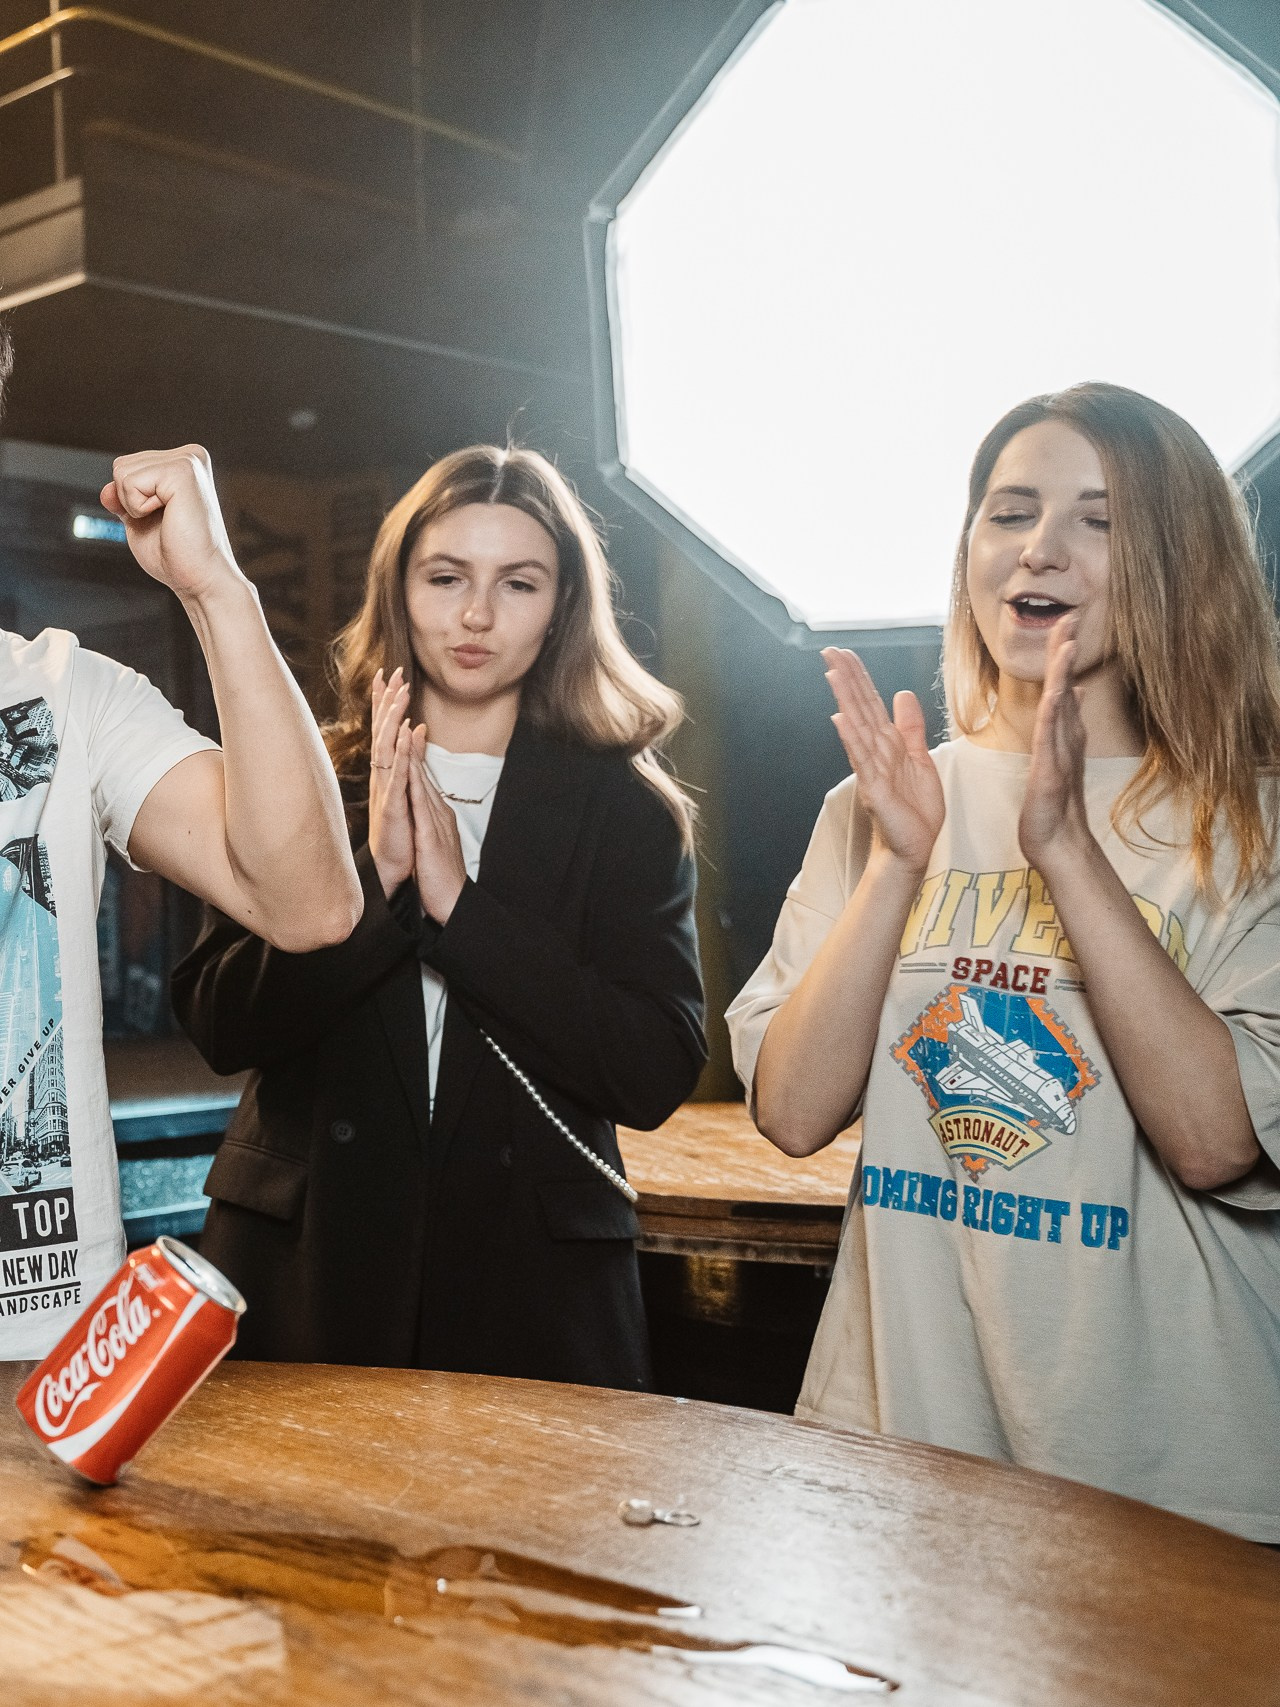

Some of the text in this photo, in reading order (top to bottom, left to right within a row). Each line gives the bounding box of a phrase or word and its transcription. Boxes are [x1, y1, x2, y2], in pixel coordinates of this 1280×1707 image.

[951, 956, 1052, 995] SPACE
[18, 1041, 42, 1074] GIVE
[42, 1017, 56, 1037] UP
[939, 1117, 1030, 1158] ASTRONAUT
[13, 1196, 70, 1239] TOP
[863, 1165, 1130, 1250] OMING RIGHT UP
[3, 1256, 44, 1287] NEW
[48, 1249, 79, 1279] DAY
